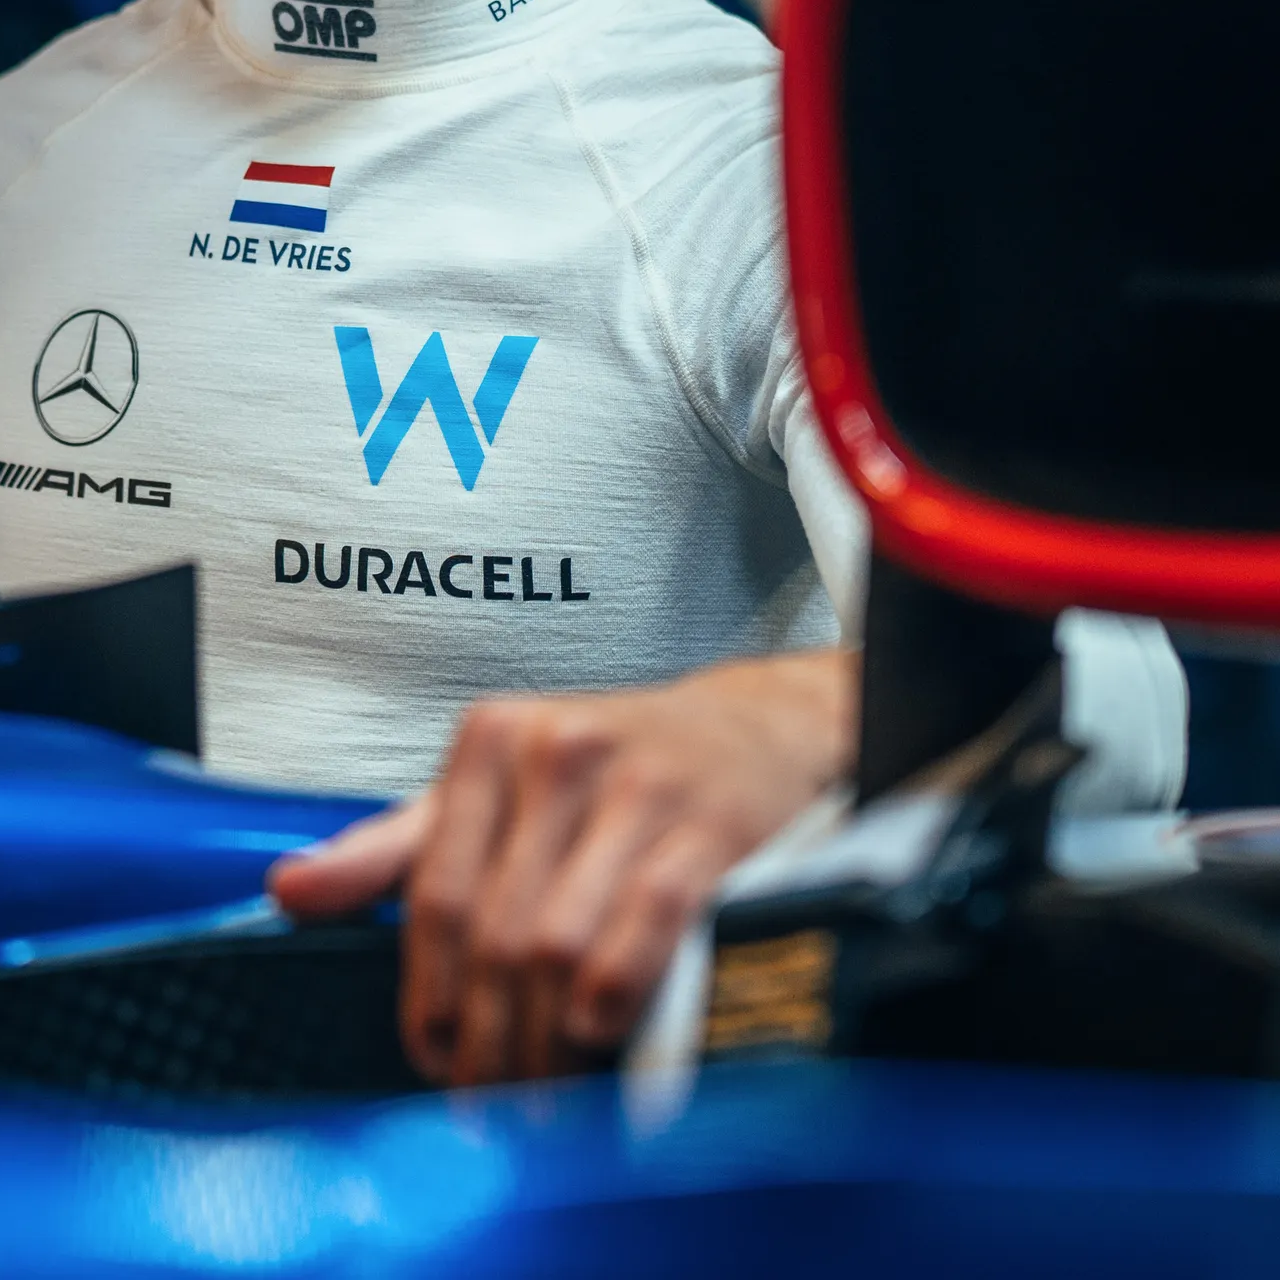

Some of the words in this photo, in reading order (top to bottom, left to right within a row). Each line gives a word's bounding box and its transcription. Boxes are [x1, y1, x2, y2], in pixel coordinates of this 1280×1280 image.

[271, 0, 377, 49] OMP
[188, 232, 214, 260] N.
[221, 235, 260, 264] DE
[268, 239, 352, 273] VRIES
[333, 325, 541, 492] W
[32, 468, 172, 508] AMG
[274, 538, 591, 602] DURACELL
